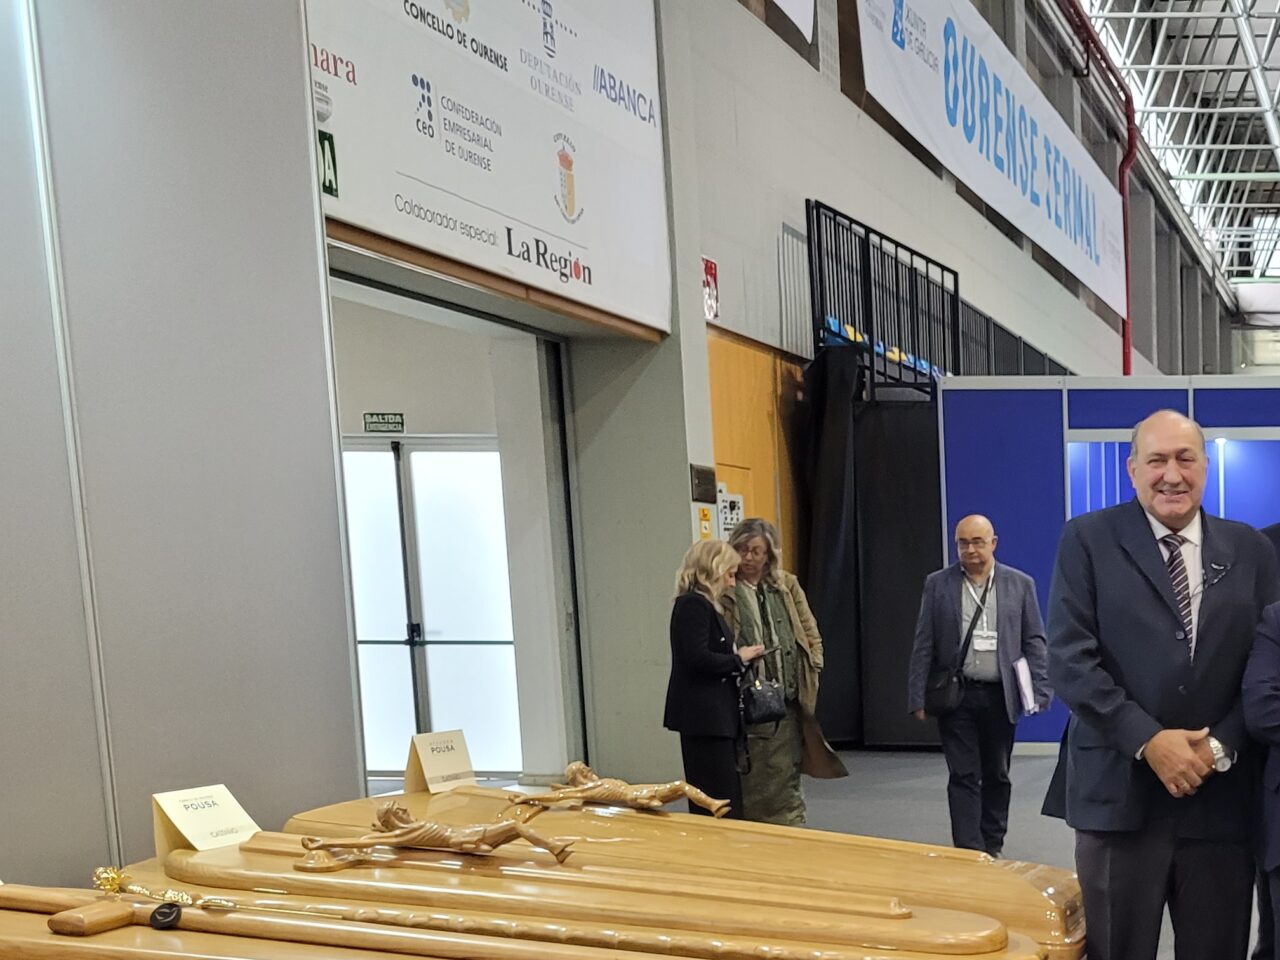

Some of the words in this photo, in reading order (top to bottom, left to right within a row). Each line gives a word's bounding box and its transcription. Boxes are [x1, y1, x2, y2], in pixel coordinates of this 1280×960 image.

[403, 2, 454, 40] CONCELLO
[456, 29, 467, 49] DE
[470, 38, 508, 72] OURENSE
[443, 117, 494, 152] EMPRESARIAL
[943, 16, 1041, 208] OURENSE
[1043, 133, 1100, 266] TERMAL
[445, 139, 456, 156] DE
[458, 145, 492, 172] OURENSE
[394, 193, 458, 232] Colaborador
[505, 226, 532, 263] La
[533, 237, 592, 285] Región
[364, 414, 402, 423] SALIDA
[430, 744, 456, 754] POUSA
[183, 800, 219, 811] POUSA
